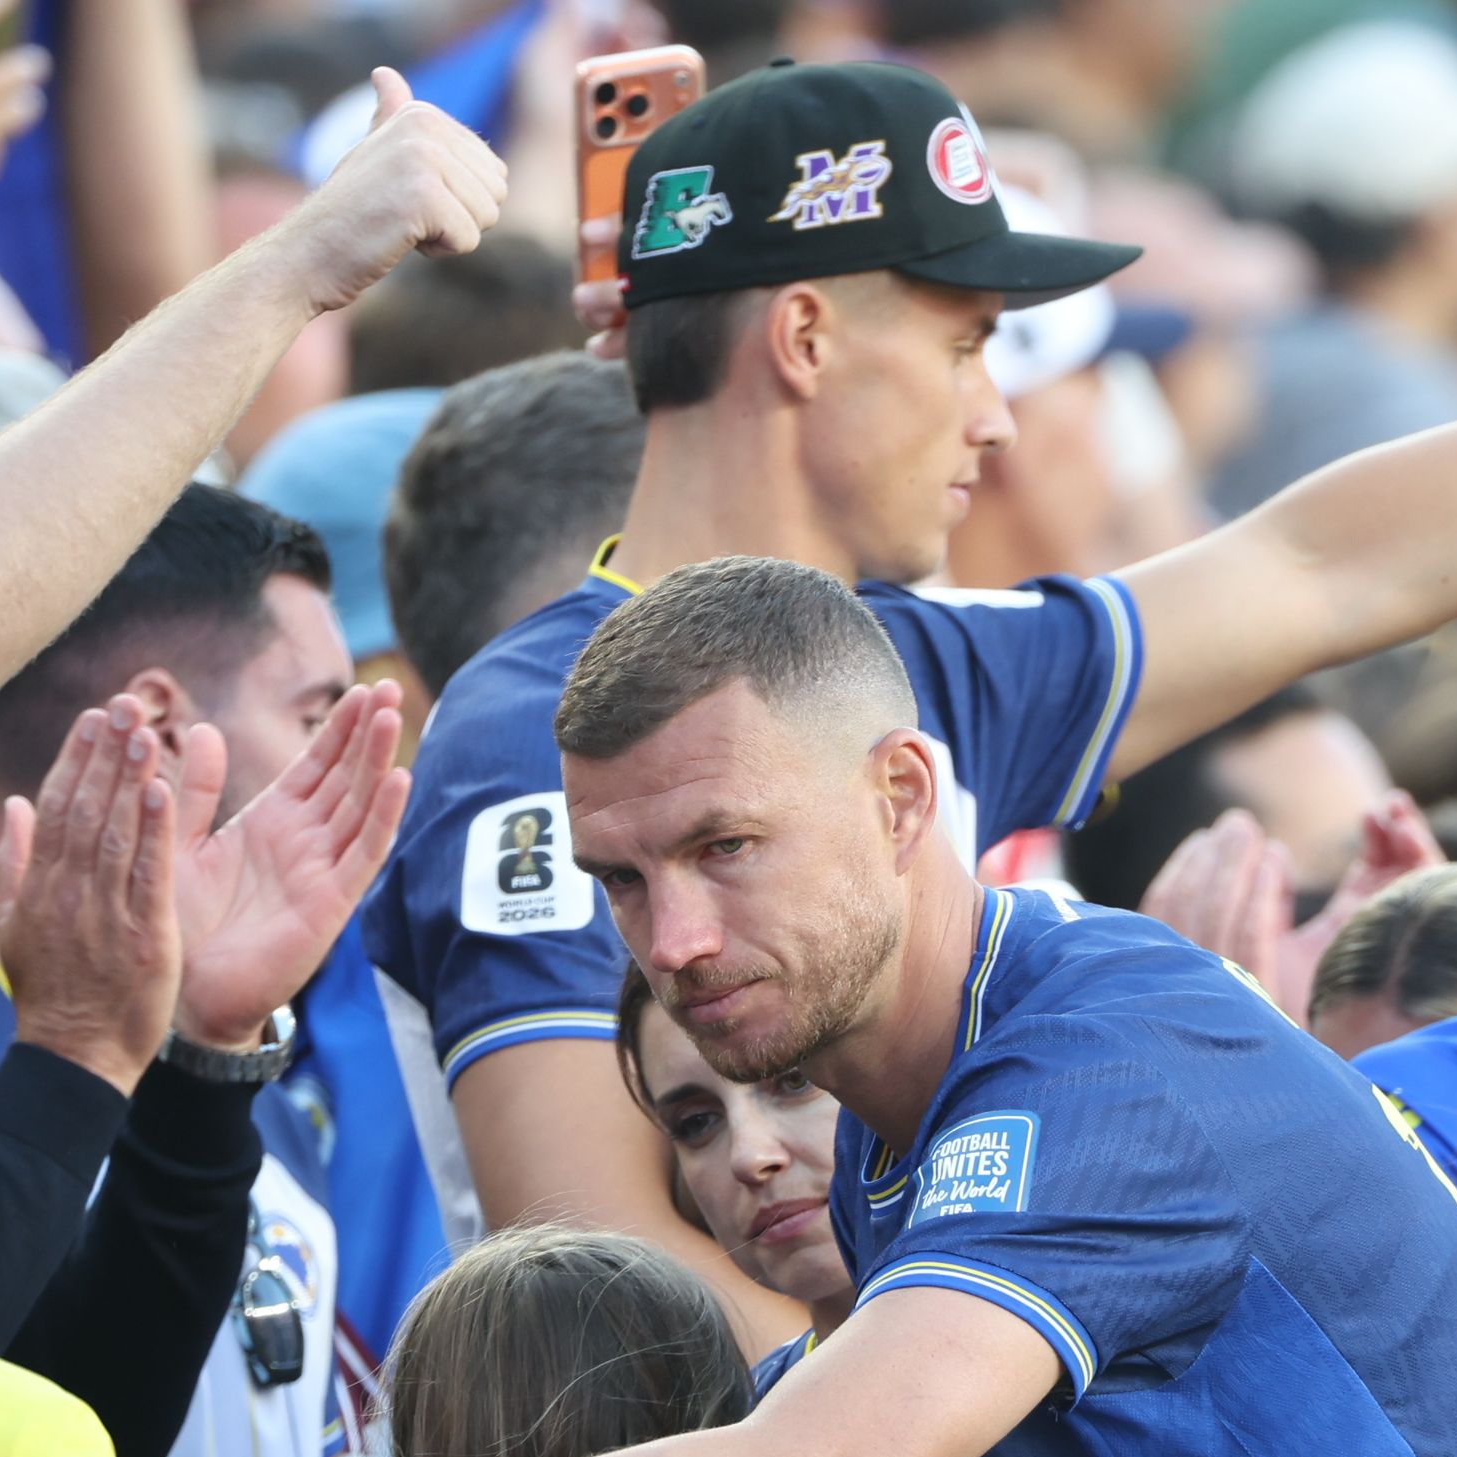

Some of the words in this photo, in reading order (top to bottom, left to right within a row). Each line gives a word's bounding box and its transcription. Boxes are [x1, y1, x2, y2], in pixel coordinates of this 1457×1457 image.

[498, 907, 556, 923] 2026
[932, 1131, 1011, 1160] FOOTBALL
[931, 1150, 1009, 1185] UNITES
[922, 1185, 948, 1209] the
[949, 1177, 1011, 1204] World
[939, 1203, 974, 1217] FIFA
